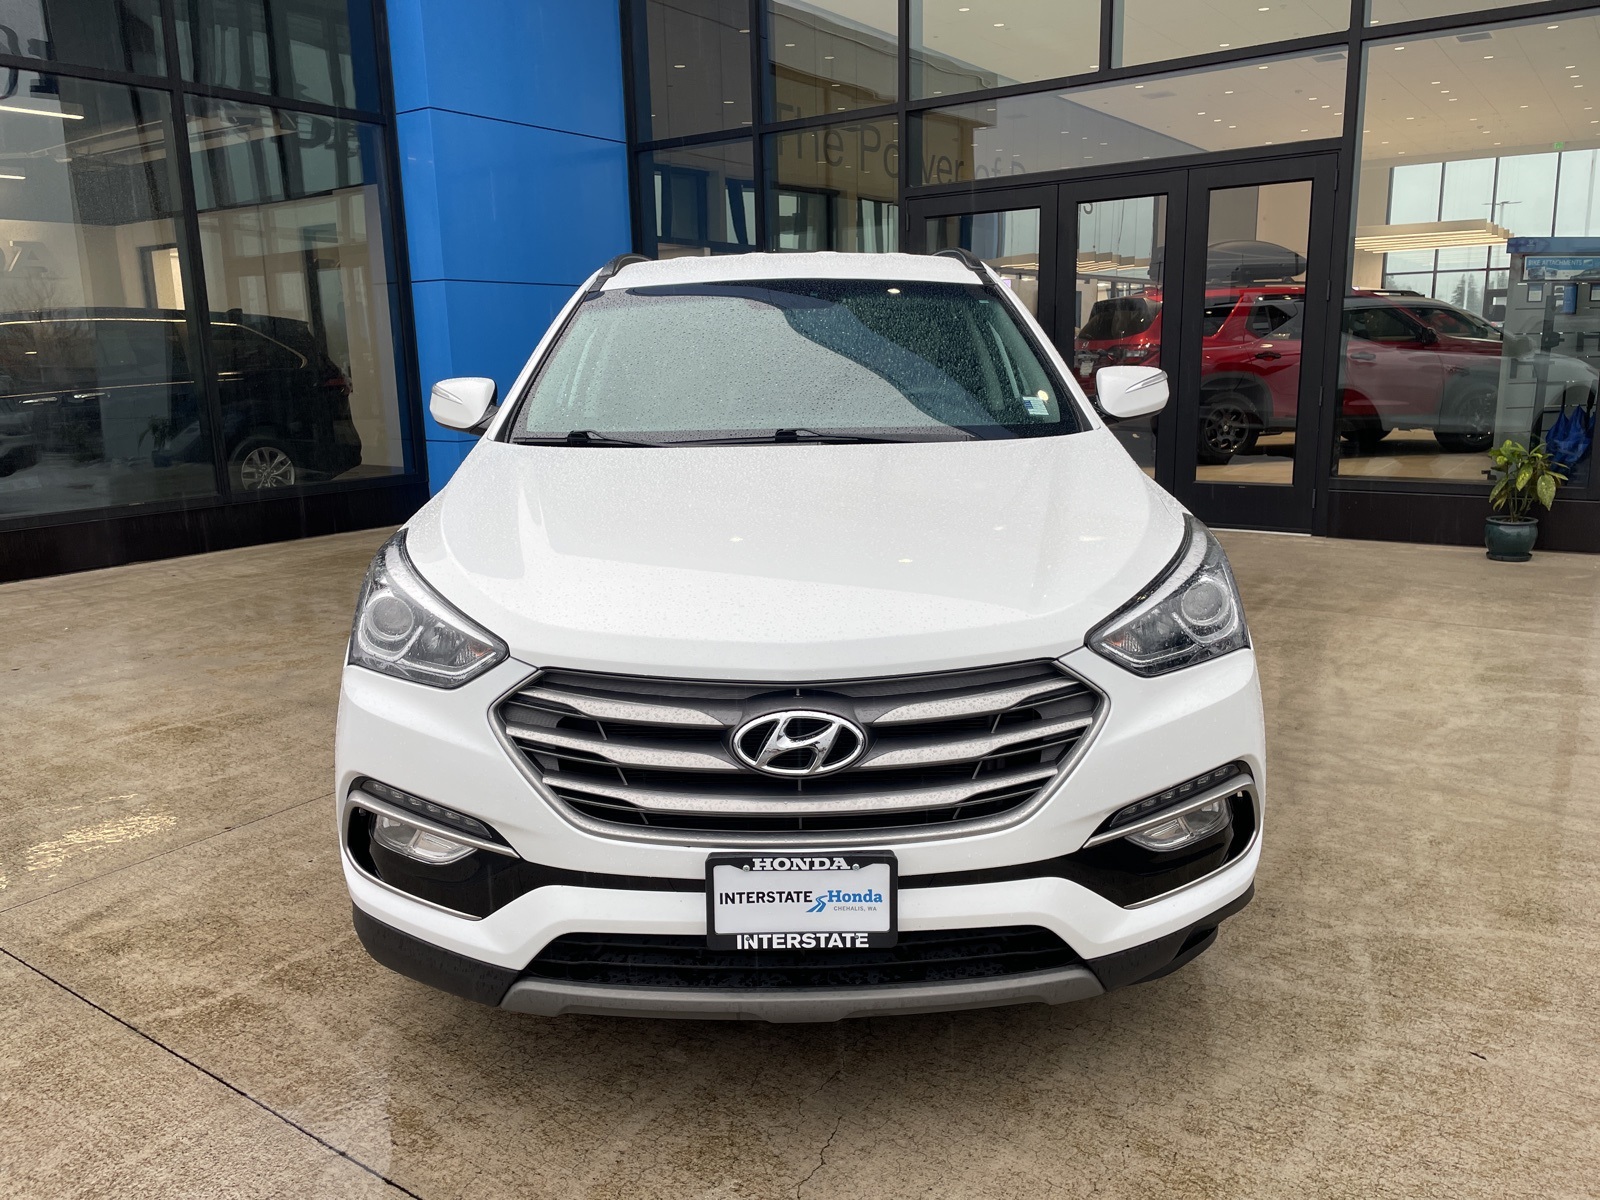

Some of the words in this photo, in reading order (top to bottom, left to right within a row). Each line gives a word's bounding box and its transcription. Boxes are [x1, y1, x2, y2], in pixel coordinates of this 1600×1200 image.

[752, 857, 851, 871] HONDA
[719, 890, 813, 905] INTERSTATE
[827, 888, 883, 903] Honda
[736, 932, 869, 950] INTERSTATE
